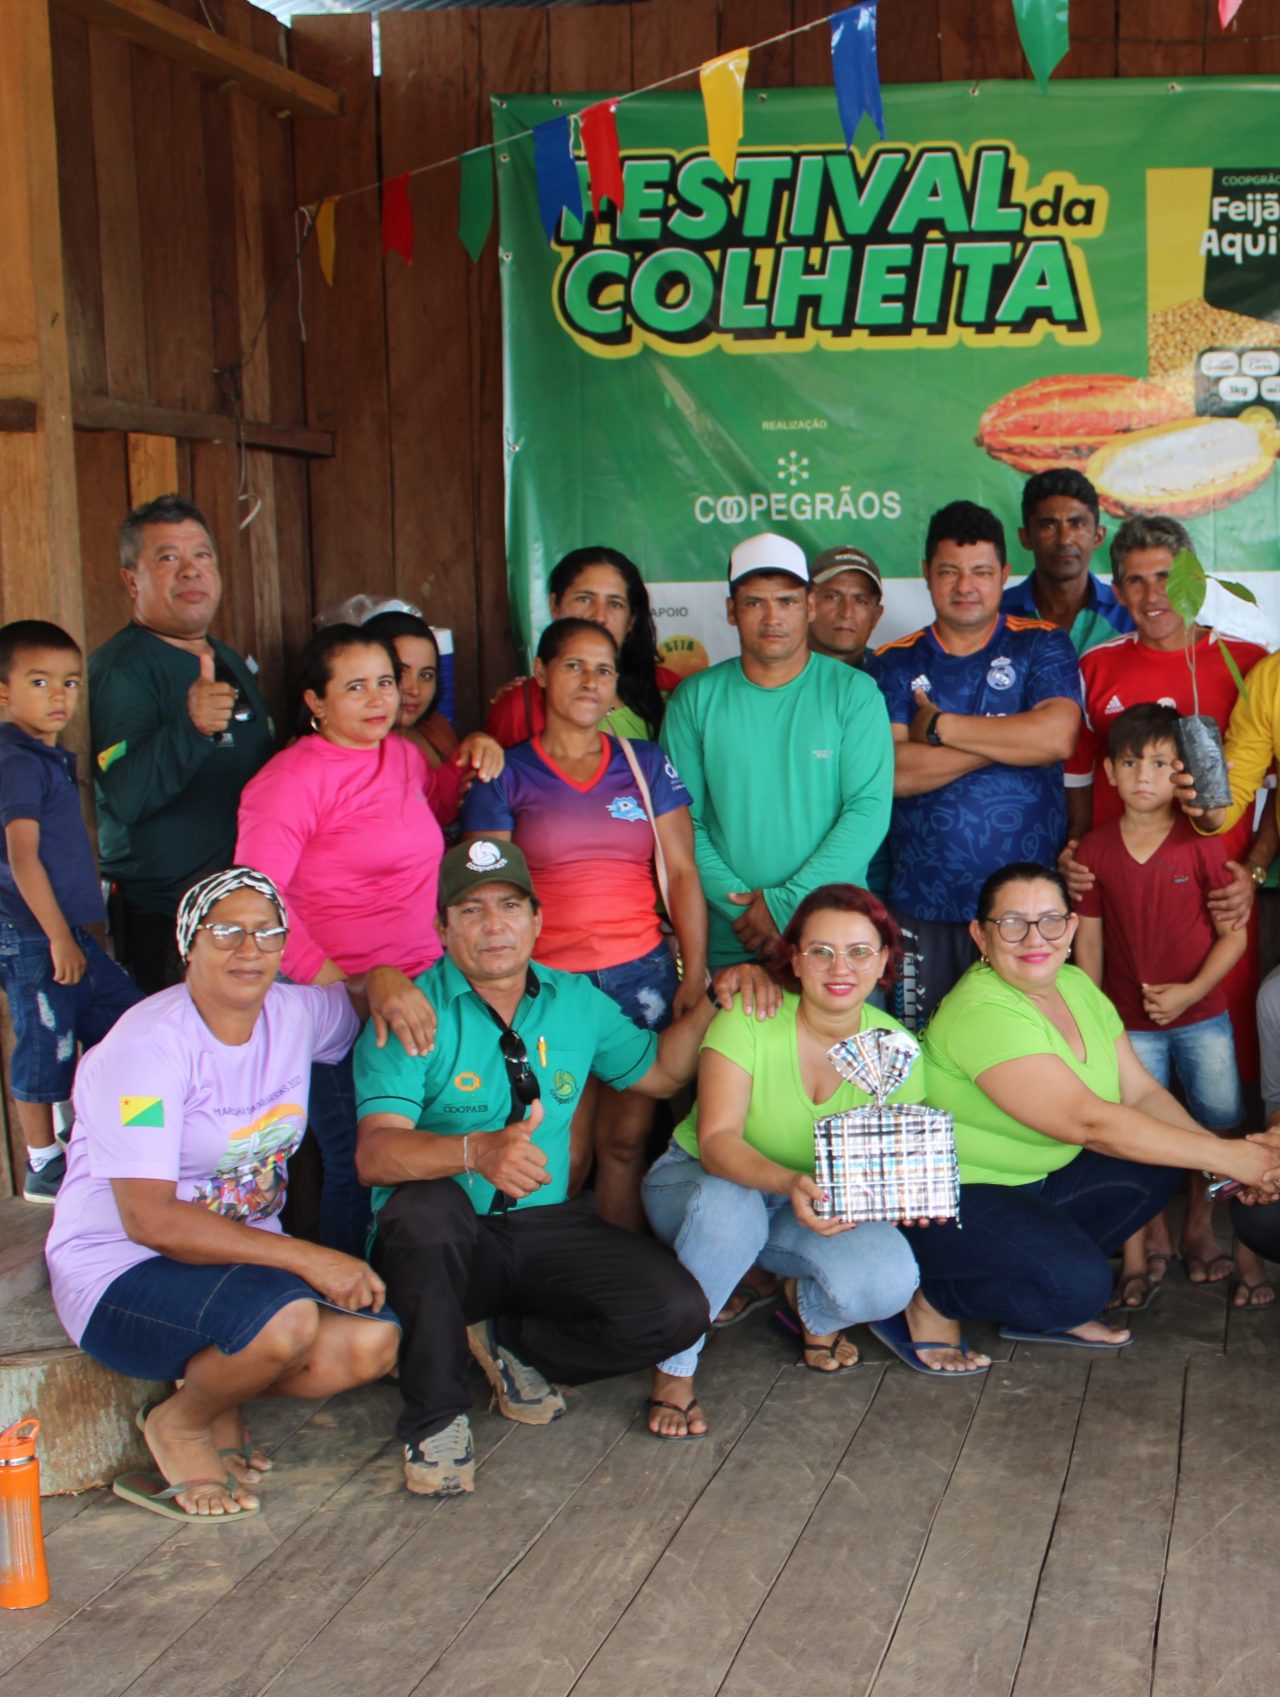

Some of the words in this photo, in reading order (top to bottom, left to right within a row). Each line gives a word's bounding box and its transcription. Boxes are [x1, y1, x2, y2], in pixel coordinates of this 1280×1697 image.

[1030, 184, 1094, 227] da
[560, 238, 1087, 343] COLHEITA
[1230, 384, 1248, 396] 1kg
[761, 418, 828, 431] REALIZAÇÃO
[694, 485, 902, 524] COOPEGRÃOS
[650, 607, 689, 618] APOIO
